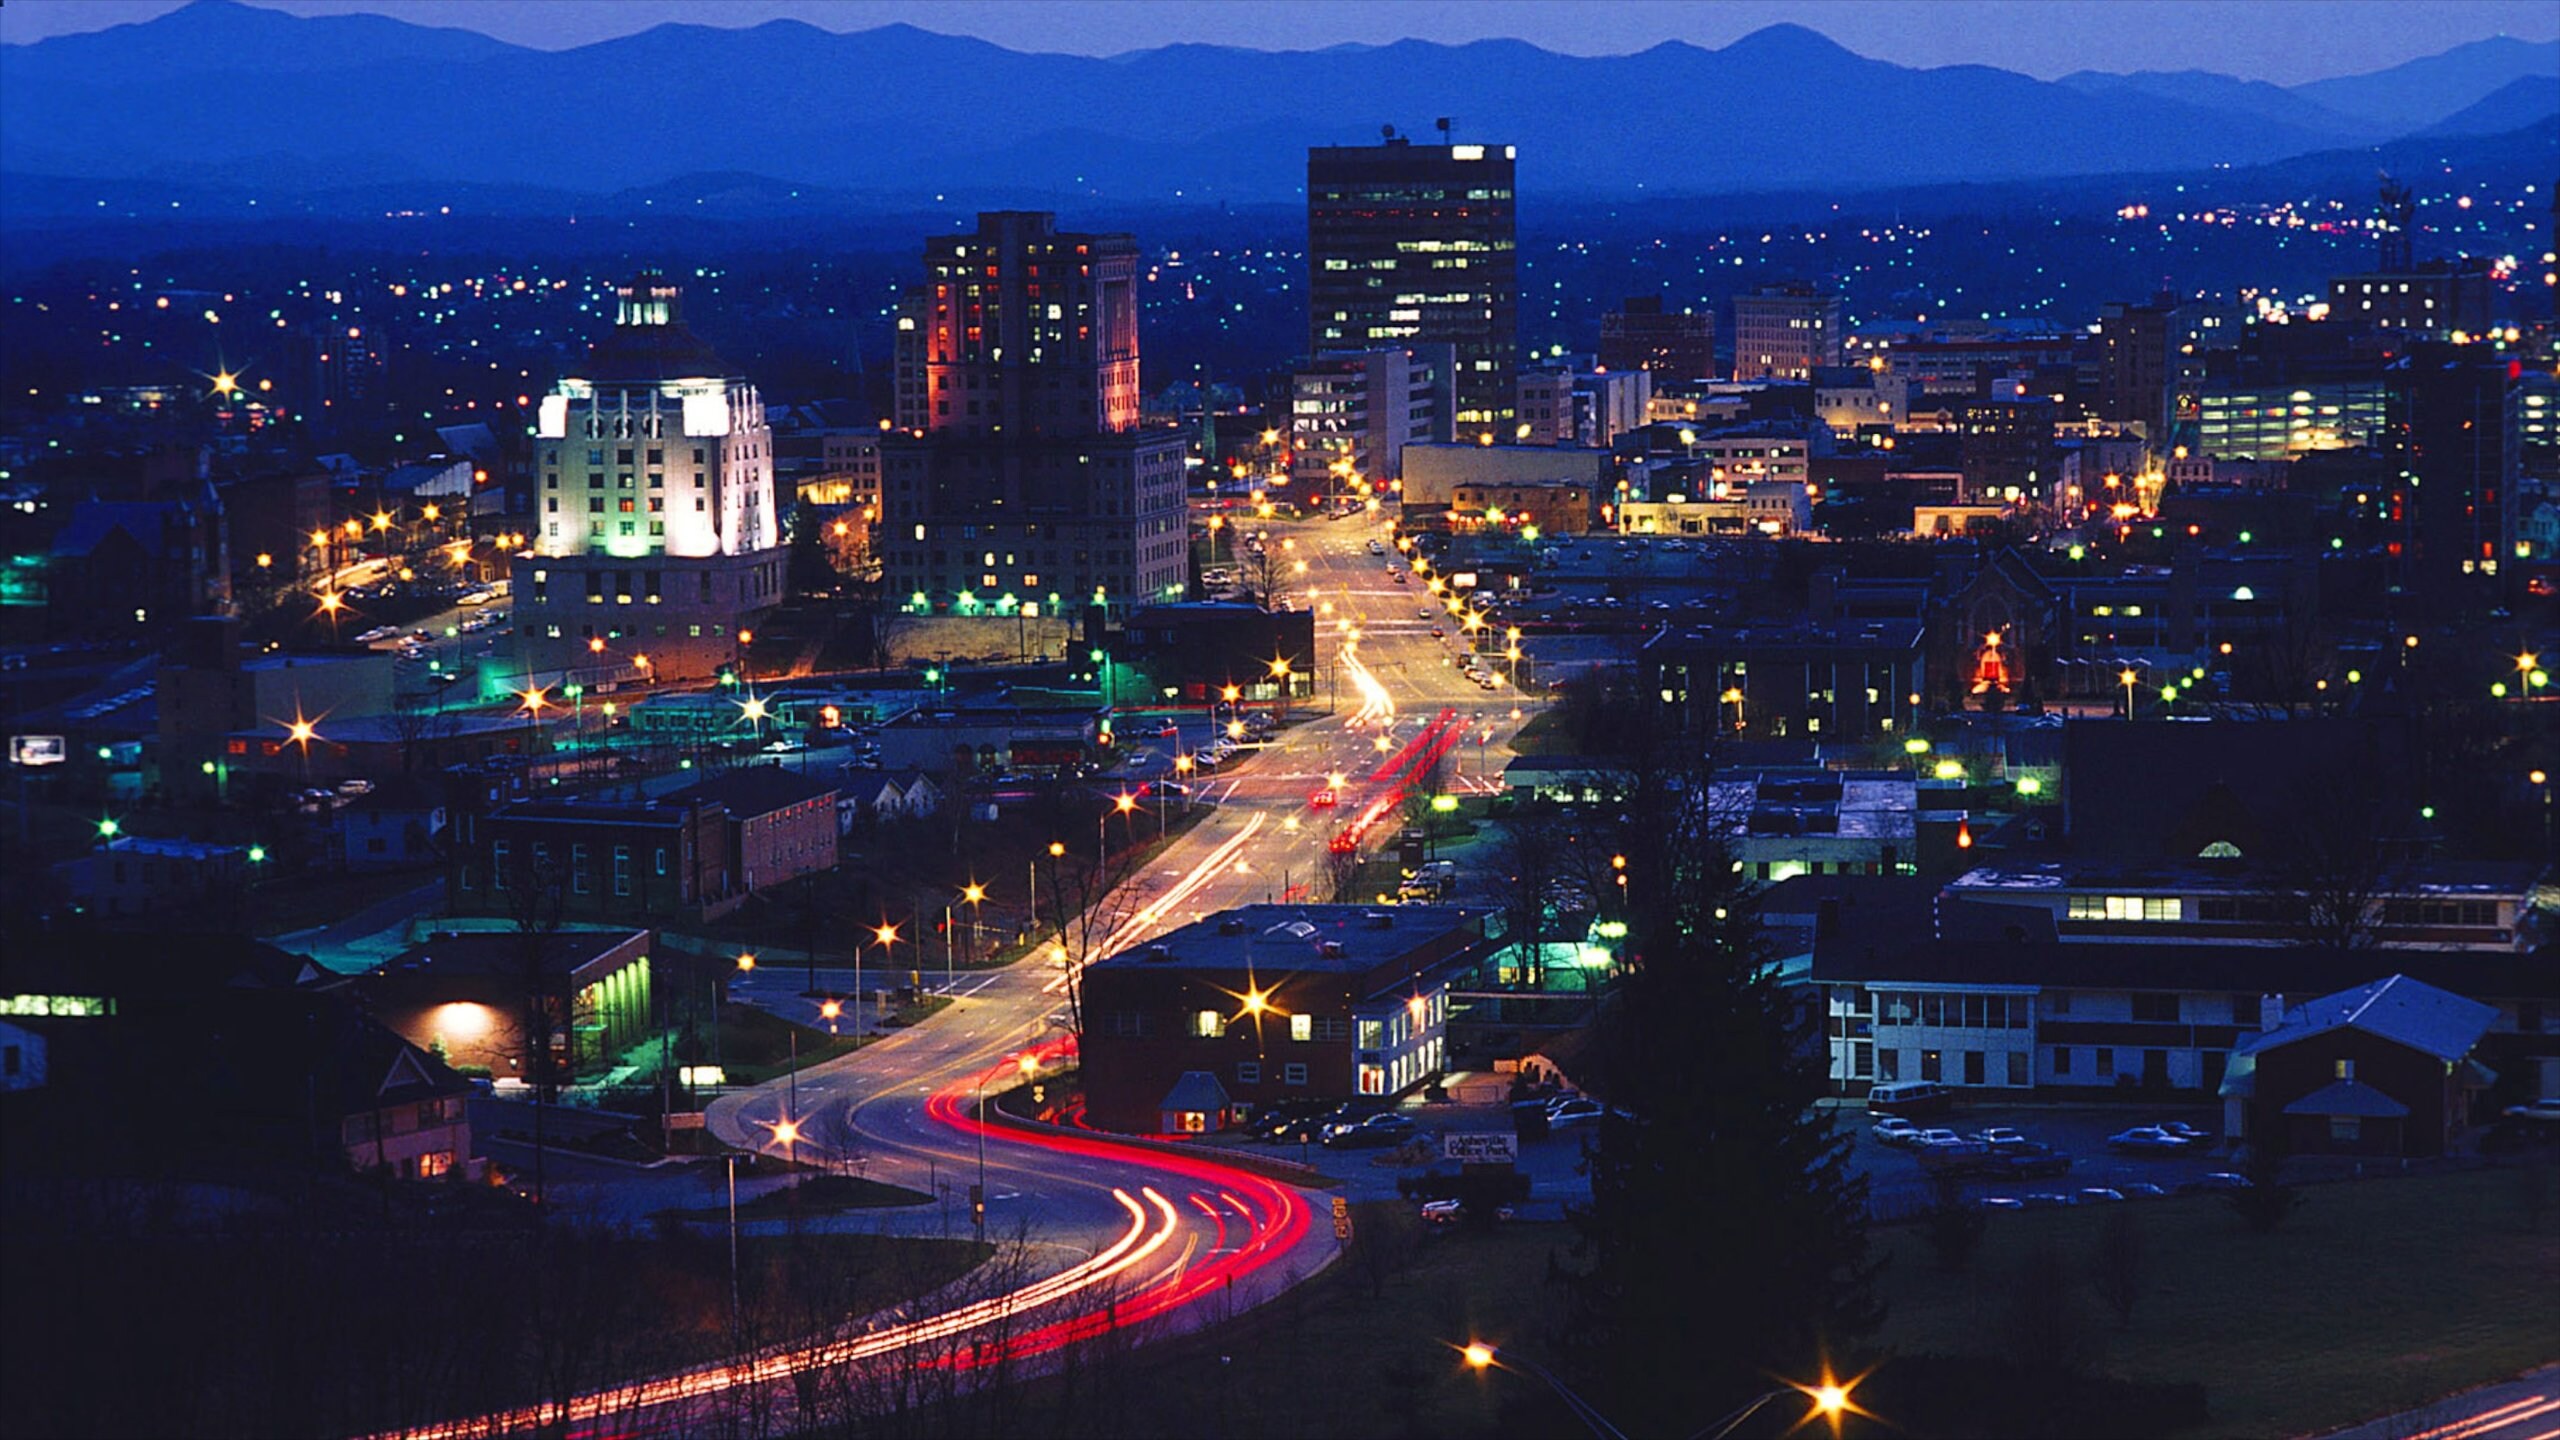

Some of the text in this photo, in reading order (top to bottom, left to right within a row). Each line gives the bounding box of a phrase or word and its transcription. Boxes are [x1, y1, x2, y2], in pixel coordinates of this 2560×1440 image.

[1458, 1136, 1507, 1146] Asheville
[1449, 1140, 1515, 1156] Office Park
